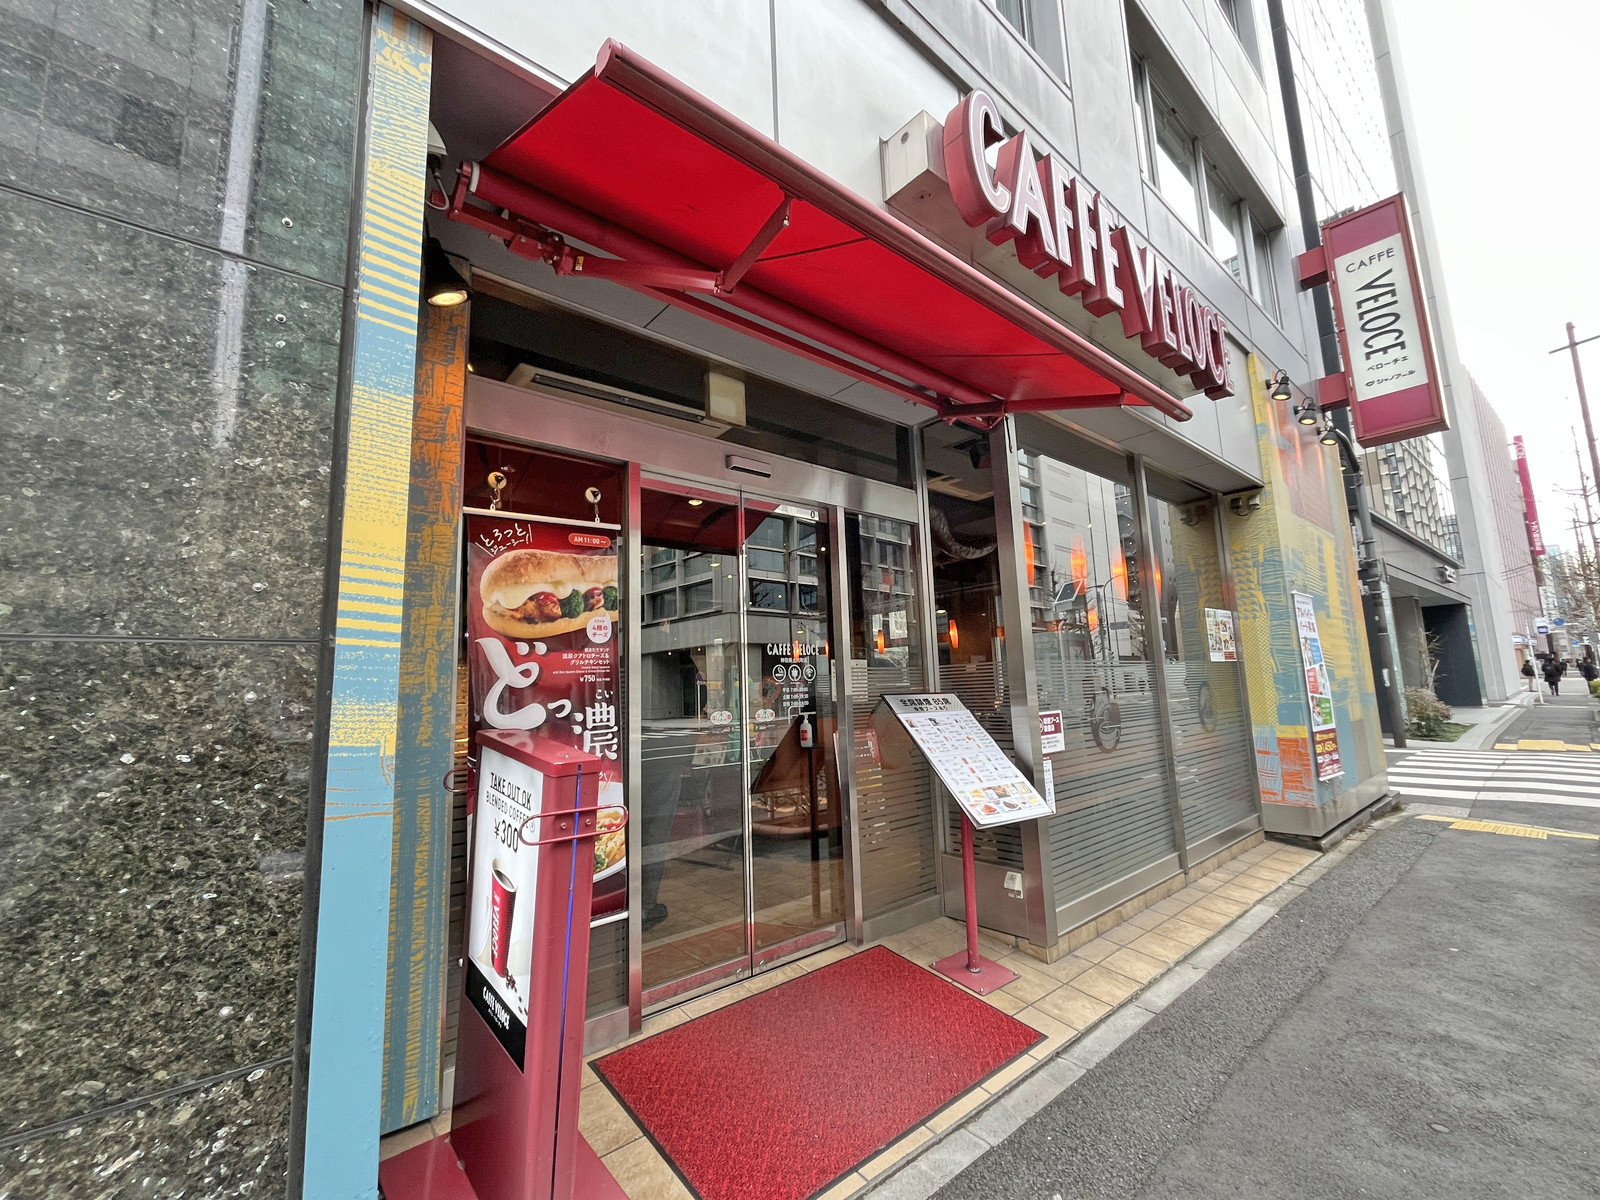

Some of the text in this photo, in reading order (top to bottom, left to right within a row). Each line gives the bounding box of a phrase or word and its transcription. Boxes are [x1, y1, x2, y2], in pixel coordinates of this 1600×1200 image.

[1113, 224, 1236, 400] VELOCE
[1354, 267, 1407, 362] VELOCE
[480, 522, 527, 547] とろっと
[595, 688, 614, 700] こい
[486, 790, 508, 814] BLENDED
[490, 772, 532, 811] TAKE OUT OK
[494, 818, 519, 853] ¥300
